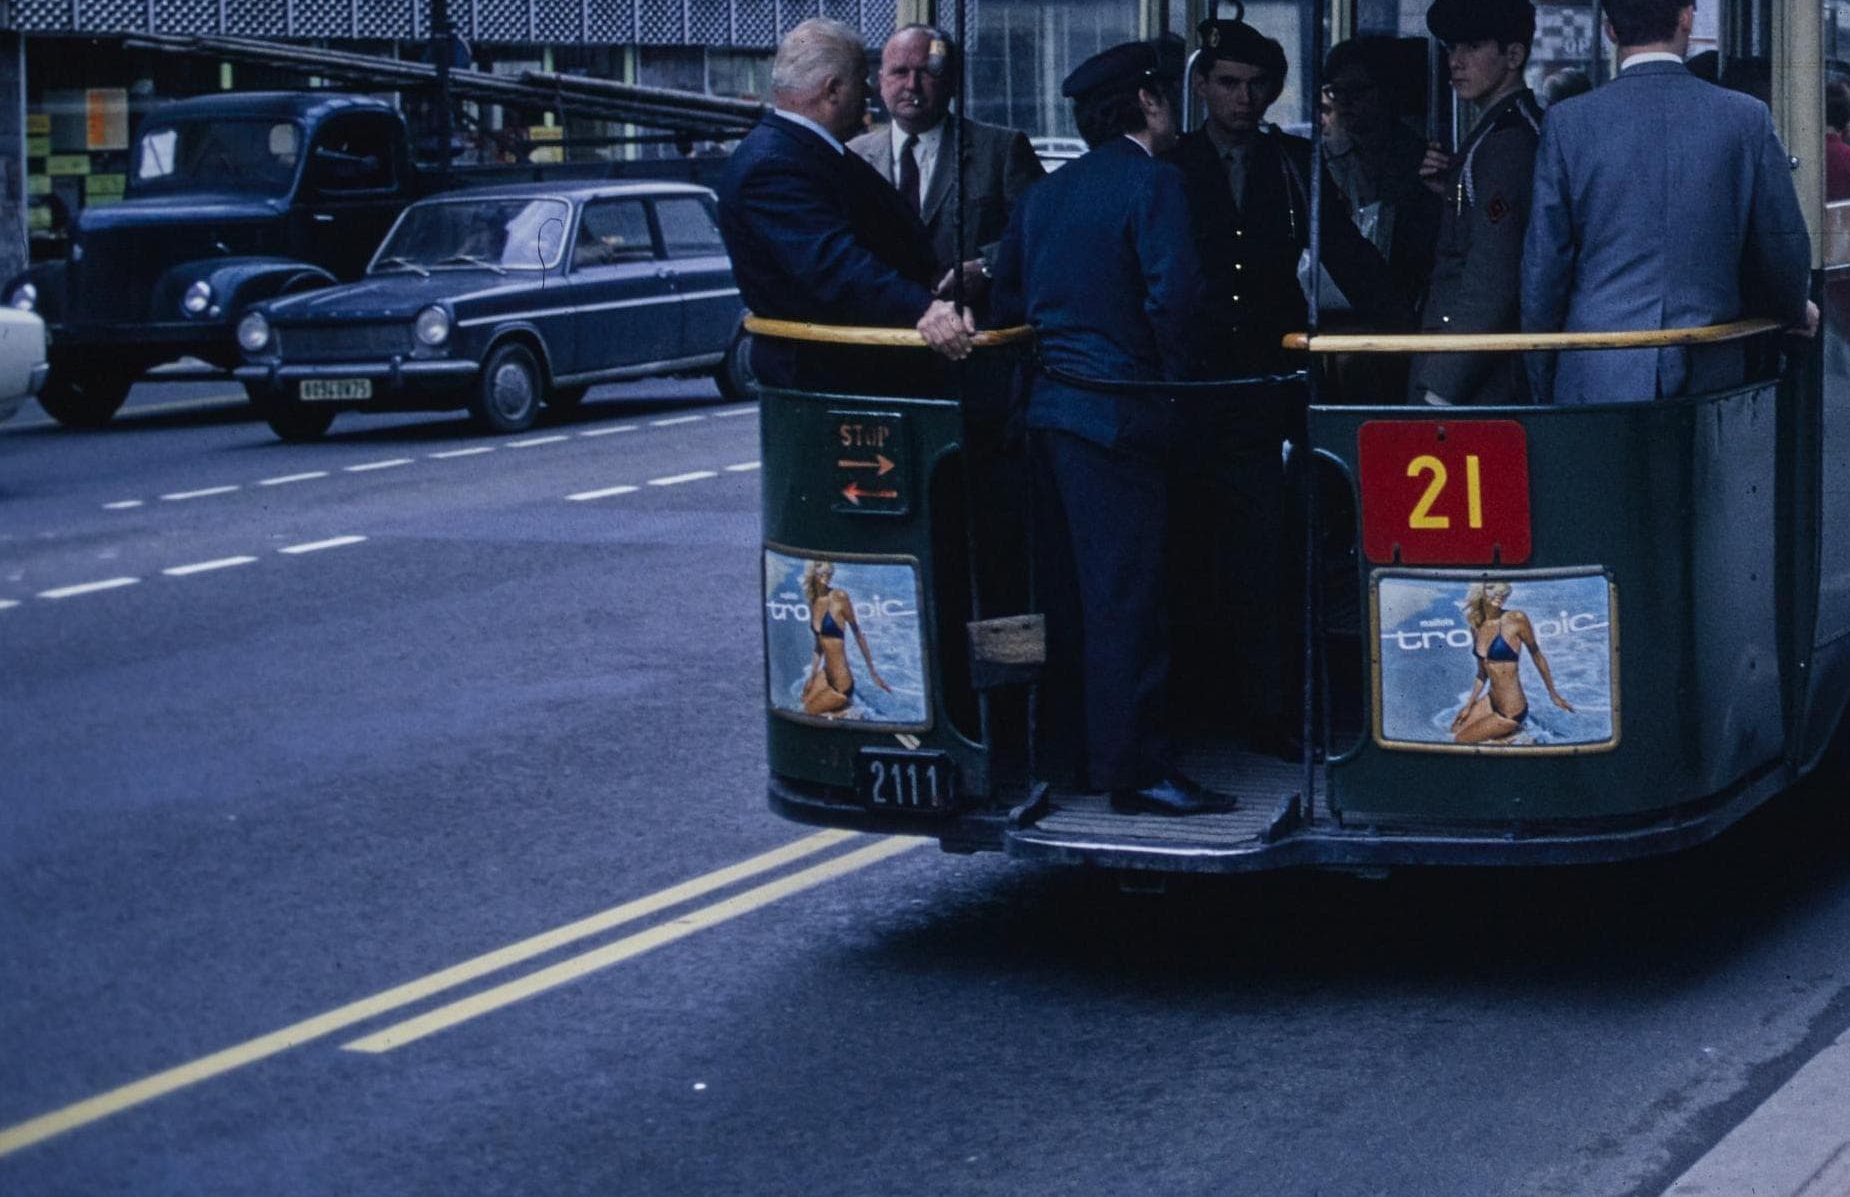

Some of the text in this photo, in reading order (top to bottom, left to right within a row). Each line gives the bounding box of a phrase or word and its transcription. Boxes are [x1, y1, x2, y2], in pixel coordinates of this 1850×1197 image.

[840, 423, 890, 448] STOP
[1407, 455, 1482, 529] 21
[870, 760, 940, 807] 2111
